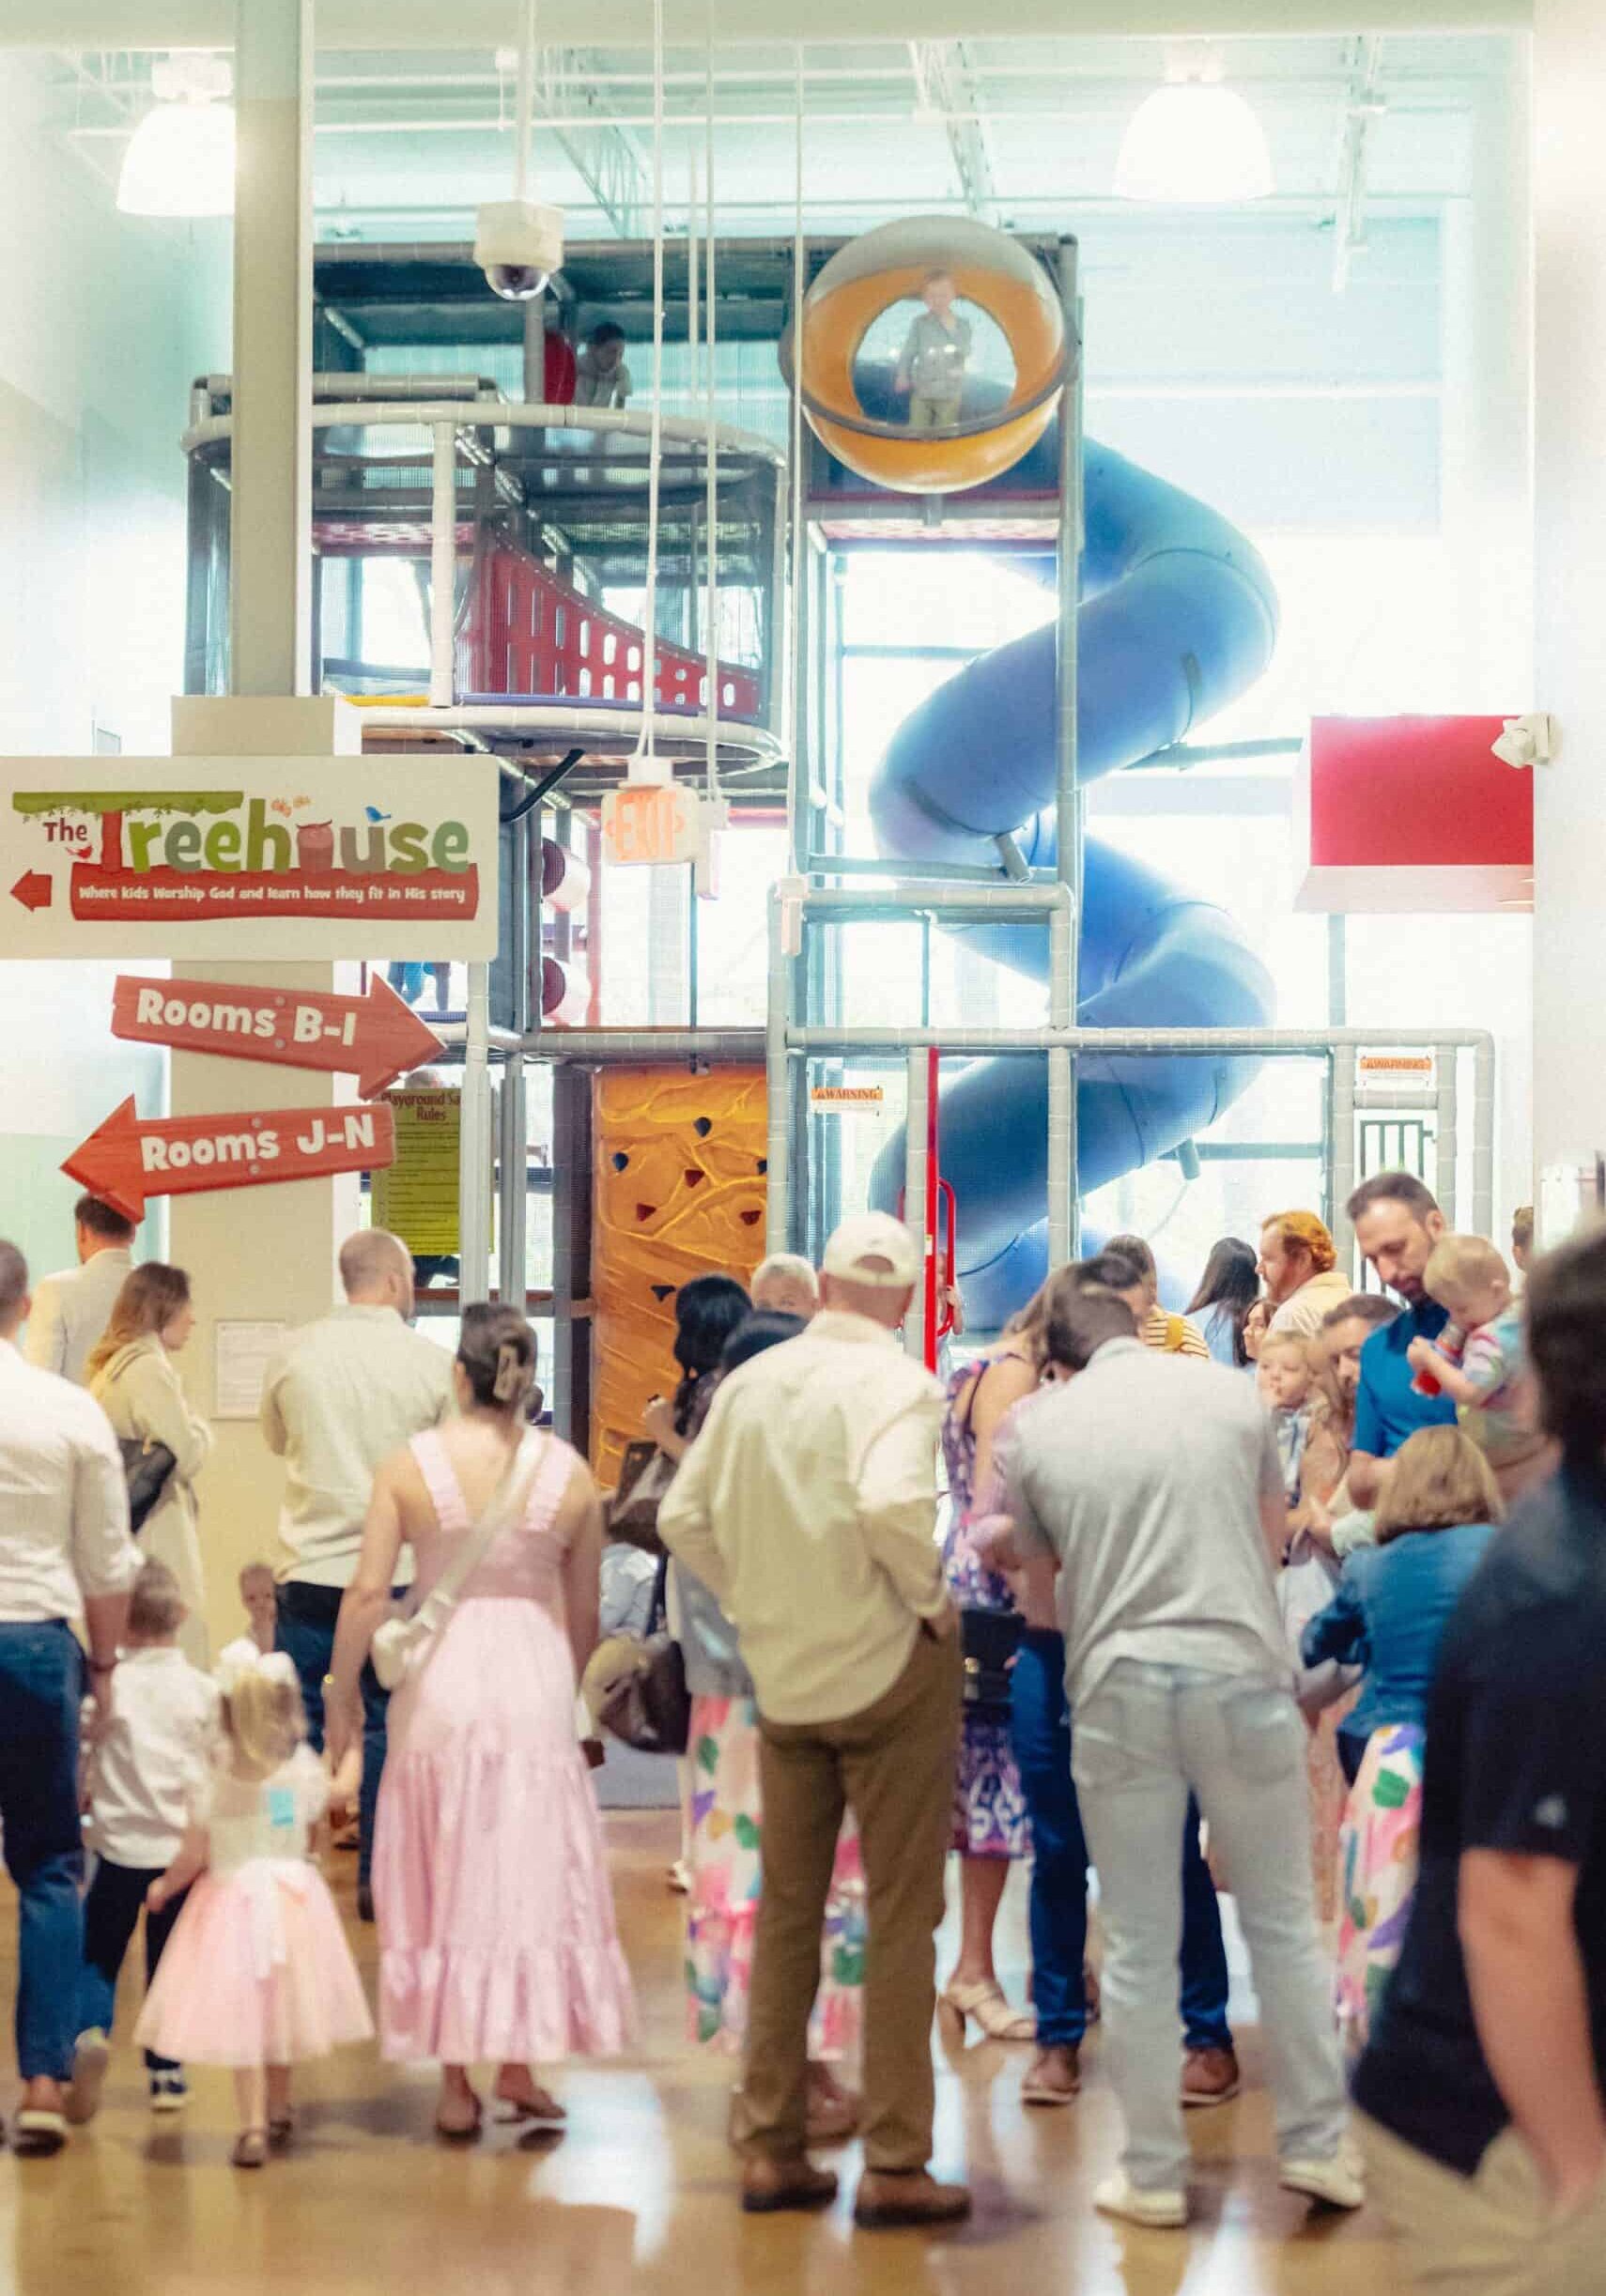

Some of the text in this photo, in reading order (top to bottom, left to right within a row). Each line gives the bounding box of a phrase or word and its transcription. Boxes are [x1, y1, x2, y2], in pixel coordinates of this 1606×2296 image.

[13, 792, 469, 875] The Treehouse
[616, 791, 677, 861] EXIT
[79, 886, 117, 900] Where
[153, 886, 206, 902] Worship
[209, 886, 236, 900] God
[239, 886, 264, 900] and
[267, 886, 301, 900] learn
[304, 886, 332, 900] how
[335, 886, 364, 903] they
[368, 886, 384, 900] fit
[388, 886, 401, 900] in
[405, 886, 426, 900] His
[430, 887, 466, 903] story
[136, 988, 358, 1047] Rooms B-I
[416, 1106, 446, 1121] Rules
[826, 1089, 879, 1100] WARNING
[141, 1114, 376, 1173] Rooms J-N
